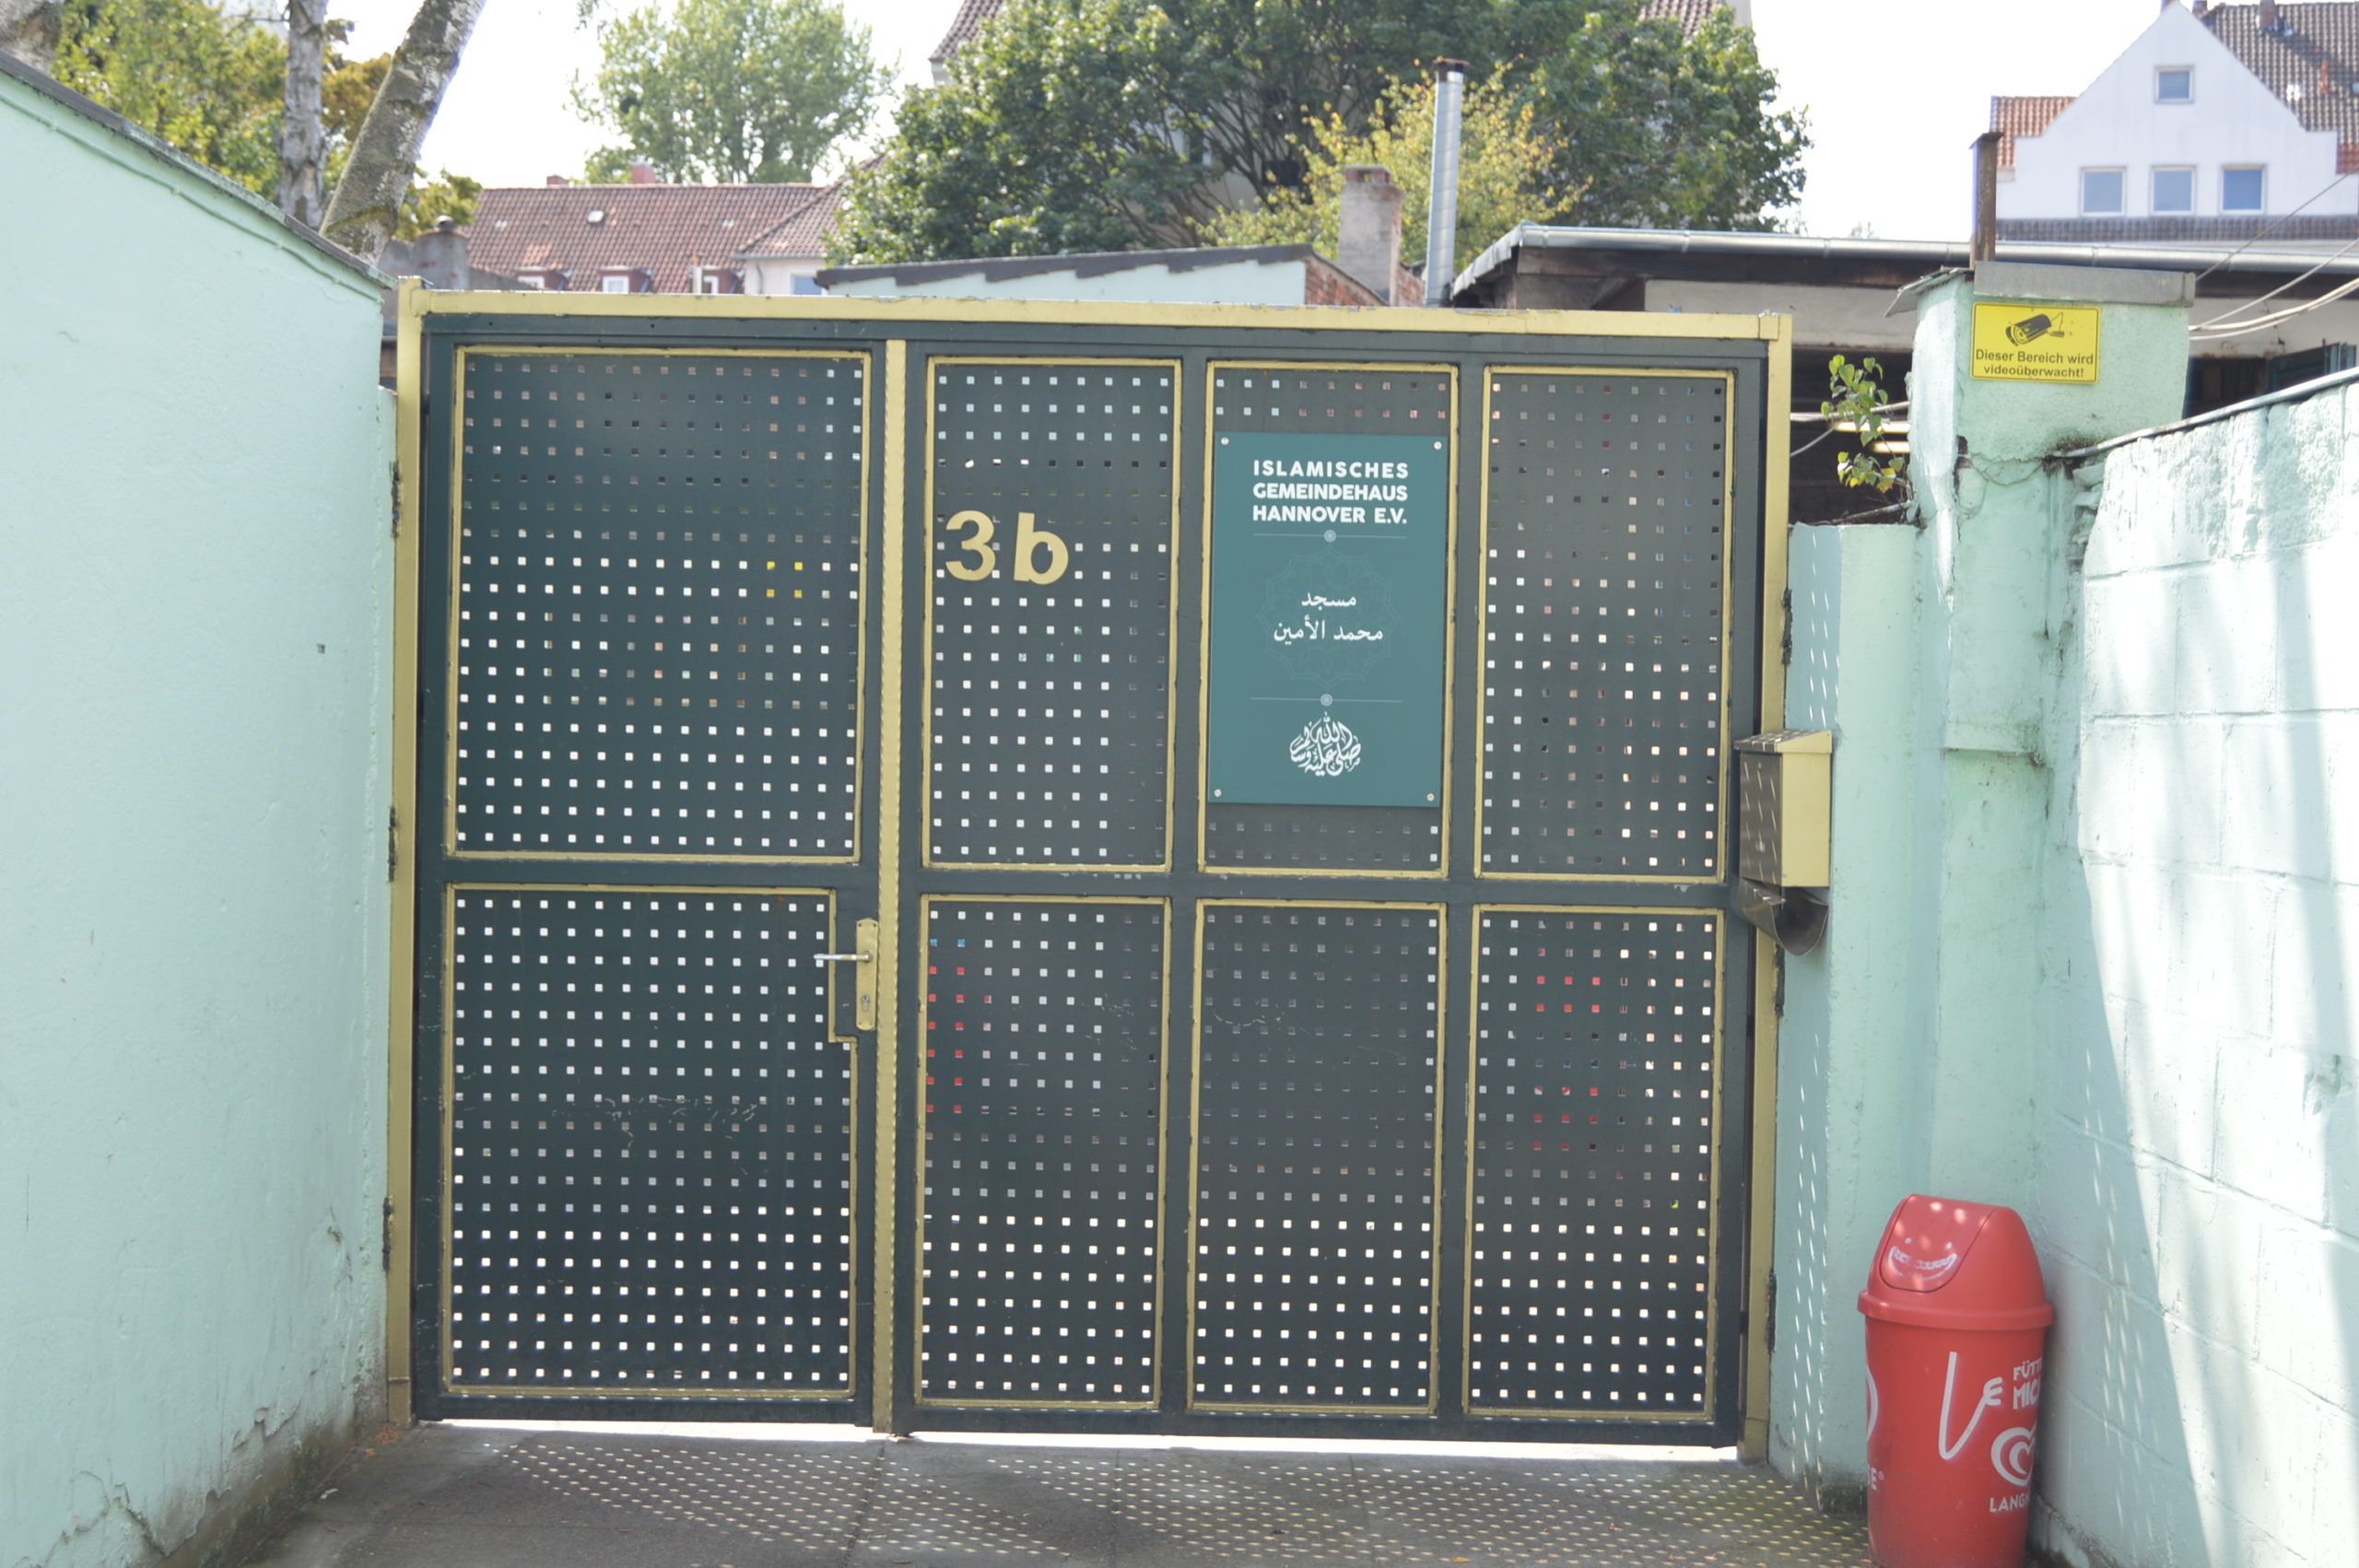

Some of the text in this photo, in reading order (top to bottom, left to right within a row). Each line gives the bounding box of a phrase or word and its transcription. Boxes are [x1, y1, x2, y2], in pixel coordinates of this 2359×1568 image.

[1976, 348, 2094, 365] Dieser Bereich wird
[1984, 365, 2084, 378] videoüberwacht!
[1253, 460, 1409, 479] ISLAMISCHES
[1252, 482, 1408, 501] GEMEINDEHAUS
[1252, 505, 1408, 524] HANNOVER E.V.
[1301, 591, 1357, 611] مسجد
[1273, 614, 1383, 645] محمد الأمين
[2013, 1376, 2041, 1410] MIC
[1989, 1492, 2030, 1513] LANG
